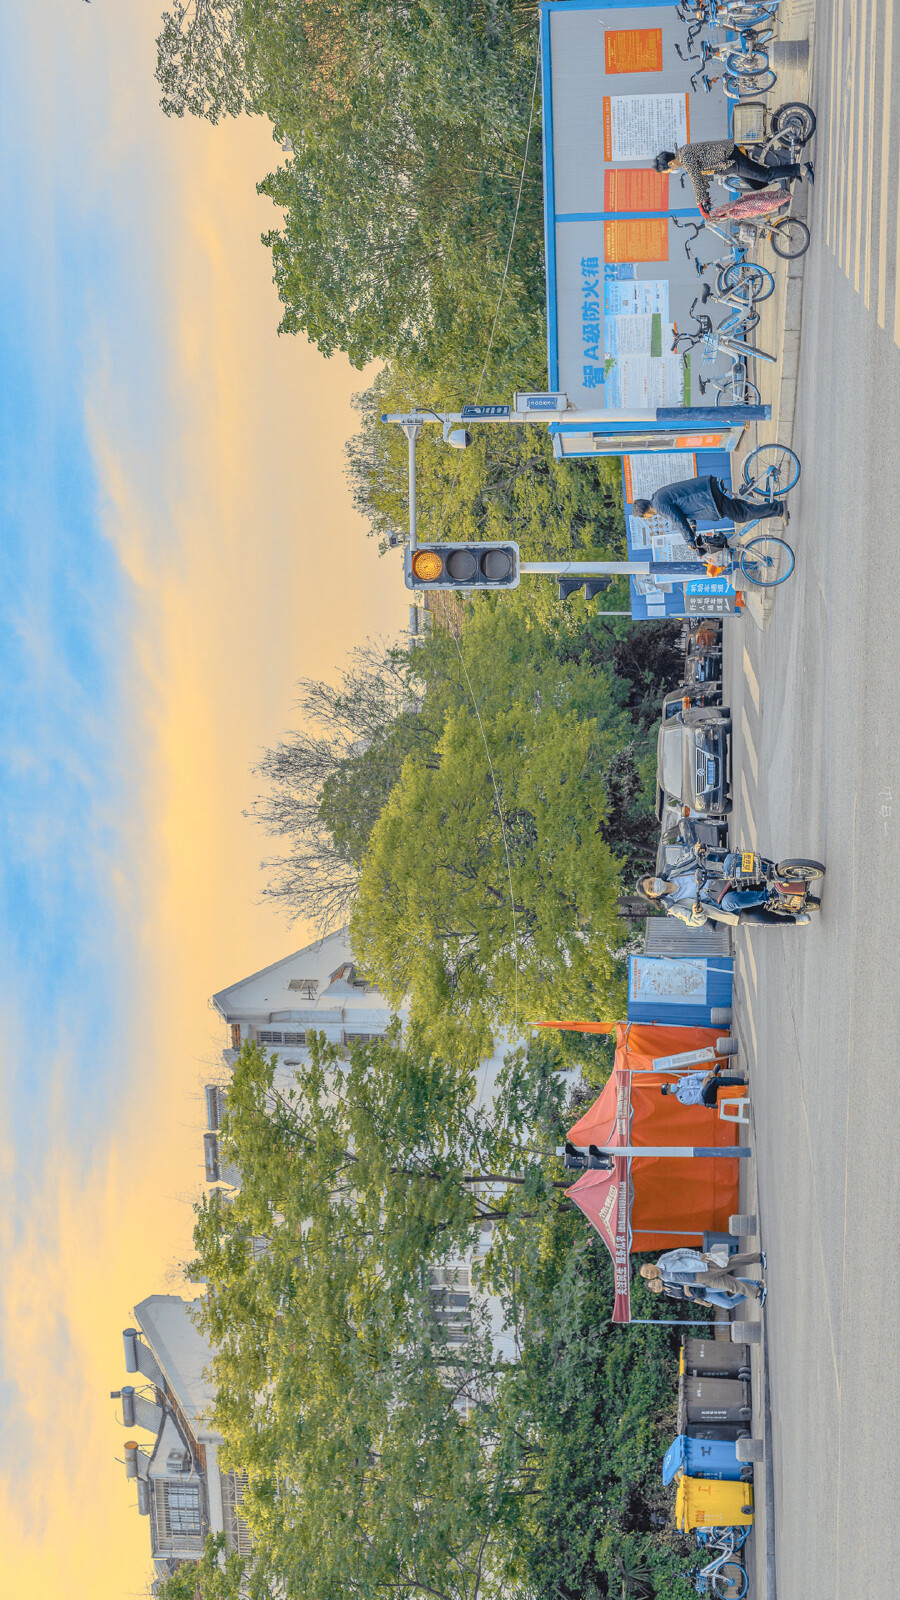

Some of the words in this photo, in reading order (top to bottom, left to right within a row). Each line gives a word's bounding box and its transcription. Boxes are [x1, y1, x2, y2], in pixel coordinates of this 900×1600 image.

[604, 264, 615, 282] 32
[581, 257, 605, 388] 智A级防火箱
[616, 1267, 627, 1295] 关注民生
